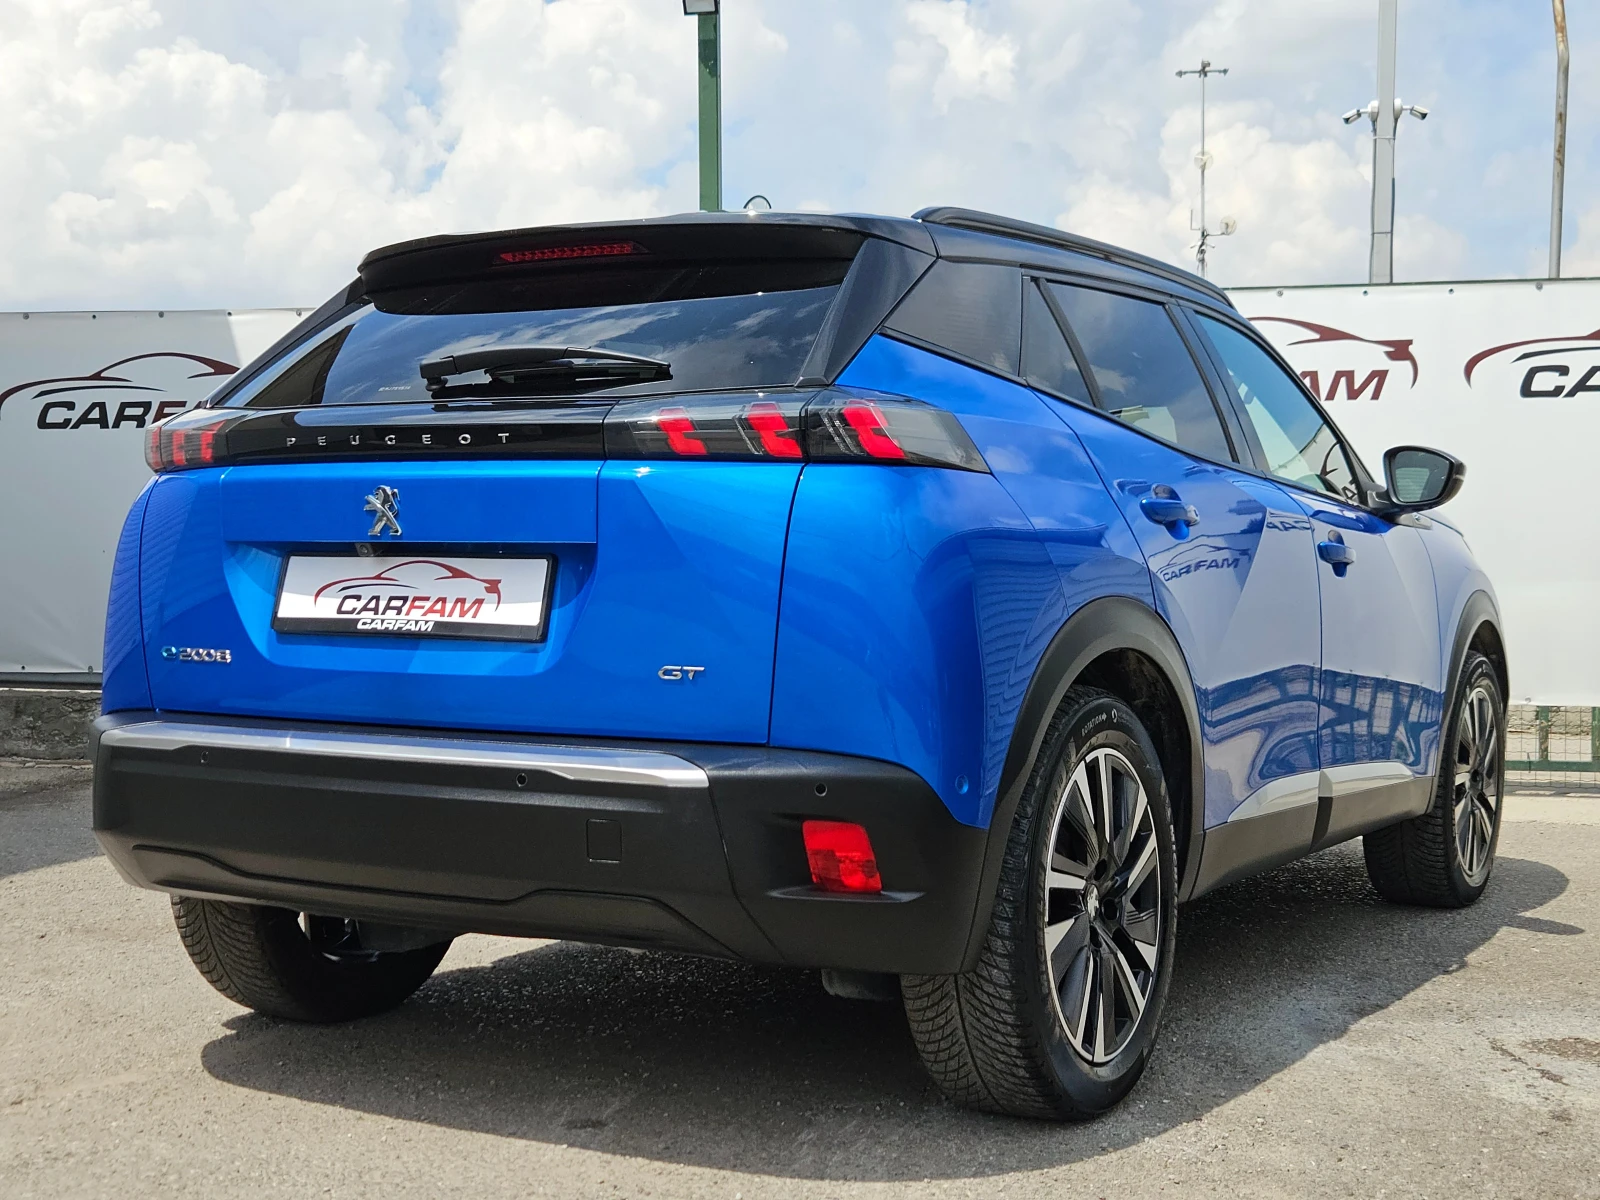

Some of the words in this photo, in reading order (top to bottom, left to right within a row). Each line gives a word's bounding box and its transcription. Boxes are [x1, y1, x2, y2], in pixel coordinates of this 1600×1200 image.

[286, 433, 510, 447] PEUGEOT
[1162, 558, 1240, 582] CARFAM
[336, 594, 486, 619] CARFAM
[356, 618, 435, 632] CARFAM
[657, 665, 705, 681] GT
